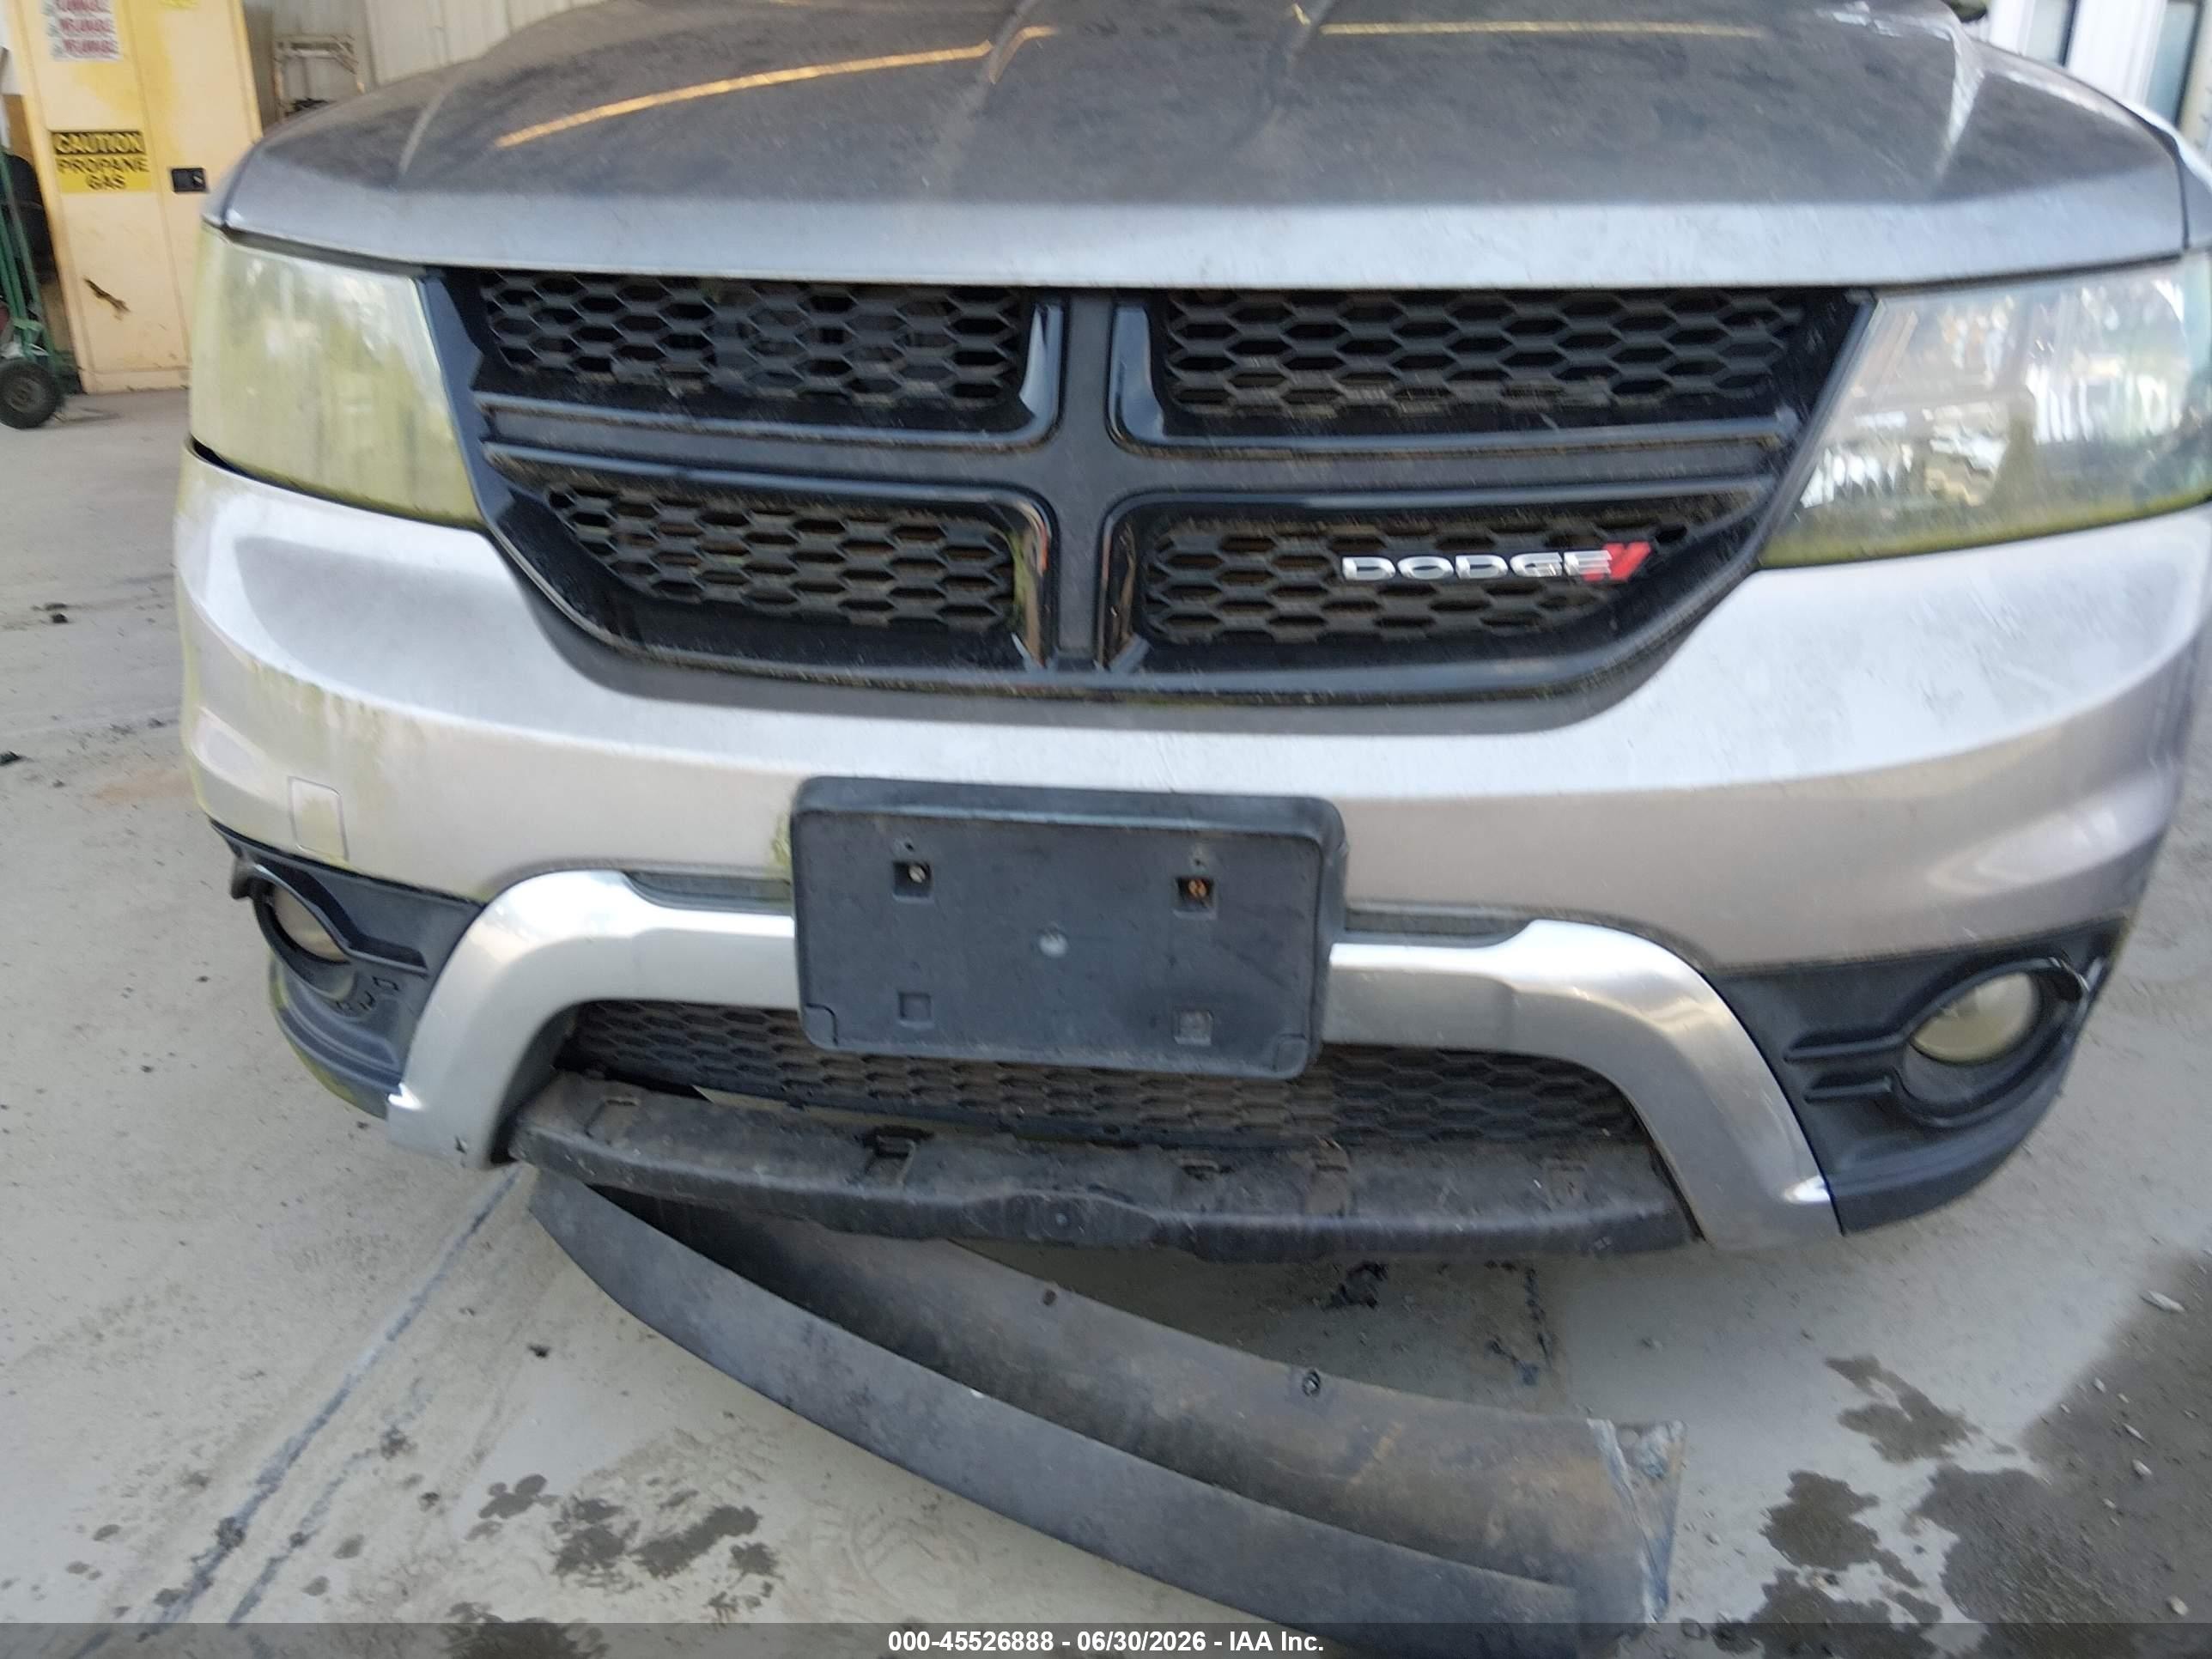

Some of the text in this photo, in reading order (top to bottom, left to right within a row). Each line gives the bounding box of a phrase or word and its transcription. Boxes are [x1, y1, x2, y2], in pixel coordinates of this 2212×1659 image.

[53, 132, 143, 154] CAUTION
[57, 156, 149, 173] PROPANE
[87, 174, 126, 190] GAS
[1341, 550, 1613, 581] DODGE
